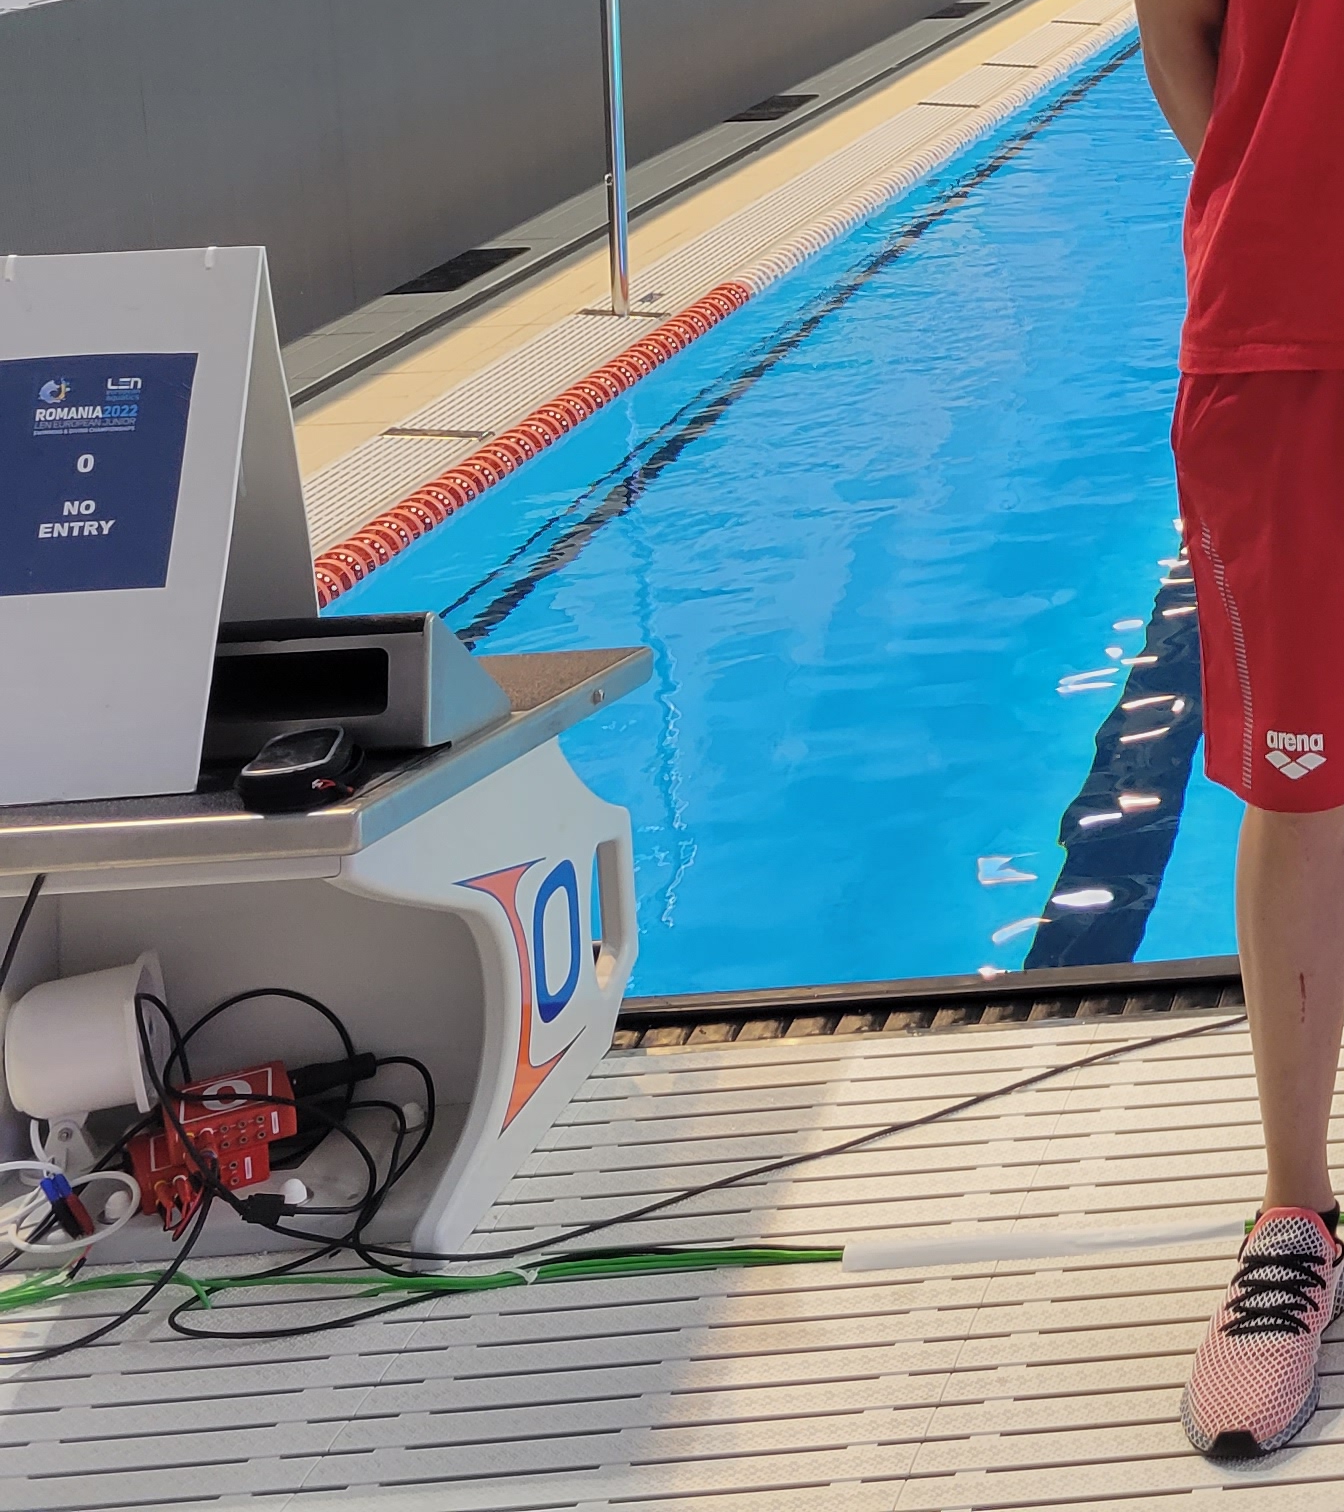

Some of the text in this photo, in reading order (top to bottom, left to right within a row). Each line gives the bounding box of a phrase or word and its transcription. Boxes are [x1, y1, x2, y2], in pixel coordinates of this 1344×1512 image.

[107, 378, 142, 389] LEN
[35, 404, 138, 422] ROMANIA2022
[53, 418, 102, 428] EUROPEAN
[102, 417, 137, 426] JUNIOR
[77, 454, 95, 473] 0
[63, 500, 96, 516] NO
[38, 520, 116, 539] ENTRY
[1266, 730, 1324, 753] arena
[533, 859, 581, 1024] 0
